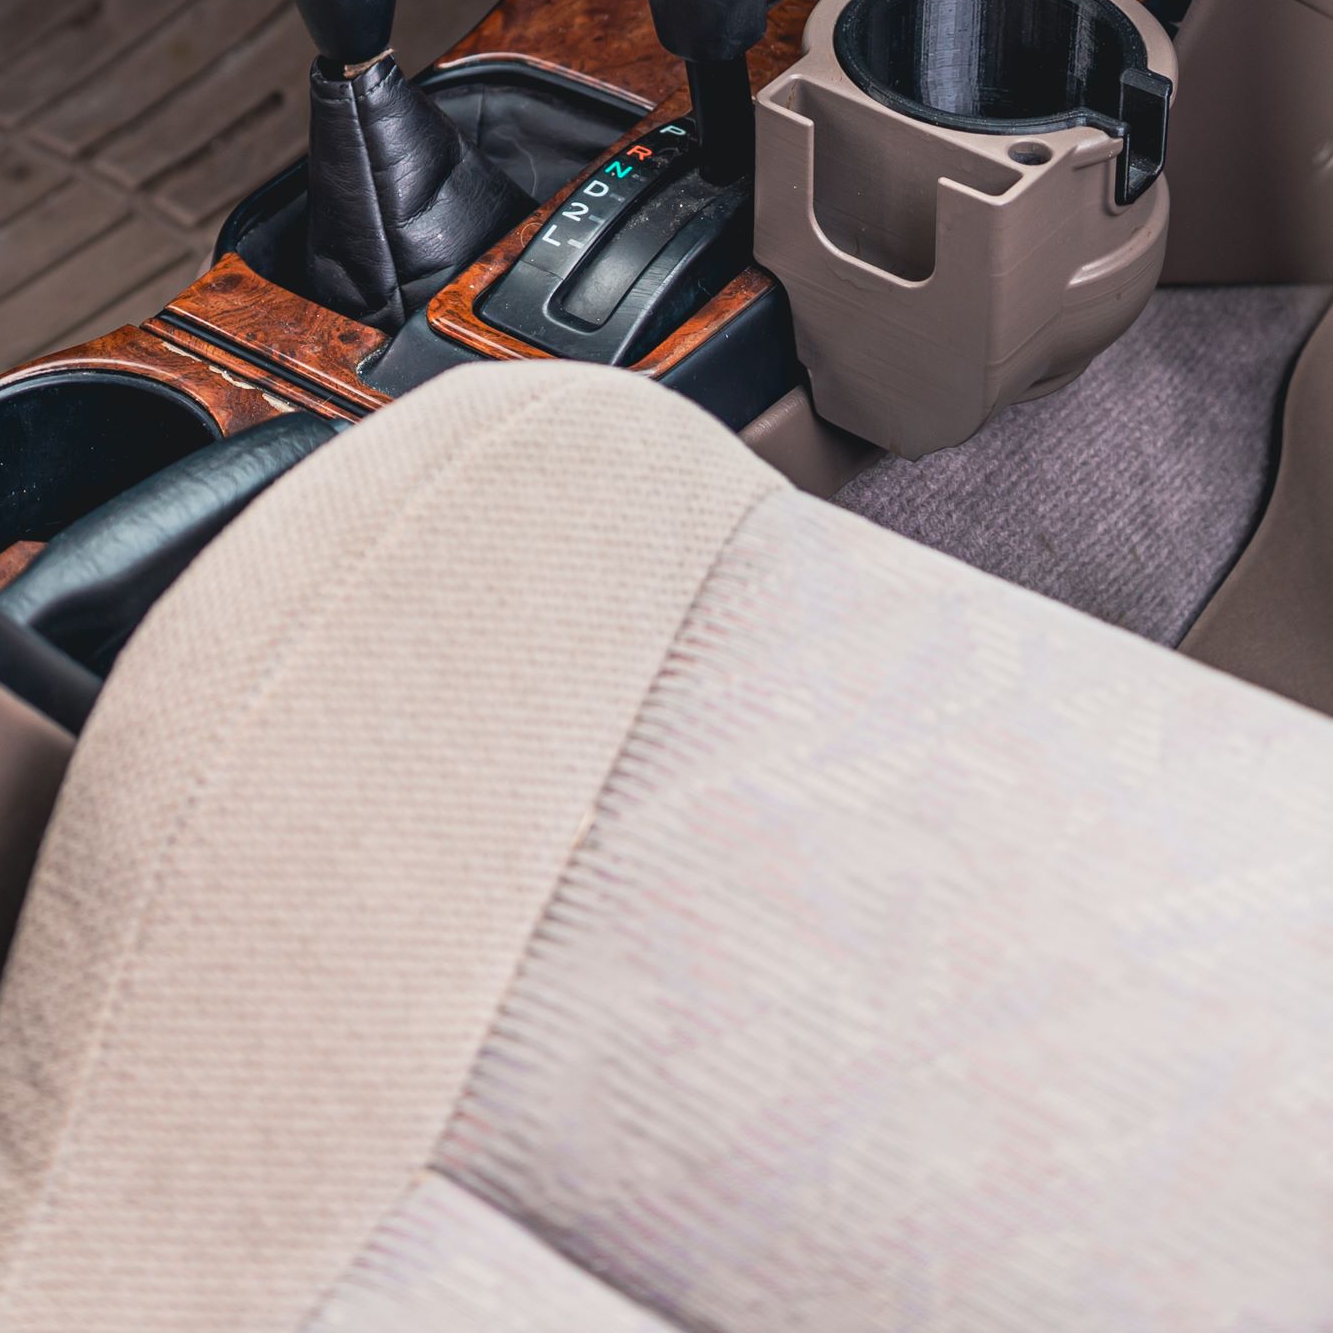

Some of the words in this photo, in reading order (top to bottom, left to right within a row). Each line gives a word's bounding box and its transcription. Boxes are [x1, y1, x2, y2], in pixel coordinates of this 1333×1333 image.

[659, 125, 686, 136] P
[626, 145, 653, 161] R
[605, 161, 633, 178] N
[583, 180, 609, 197] D
[562, 202, 589, 222] 2
[541, 224, 561, 247] L
